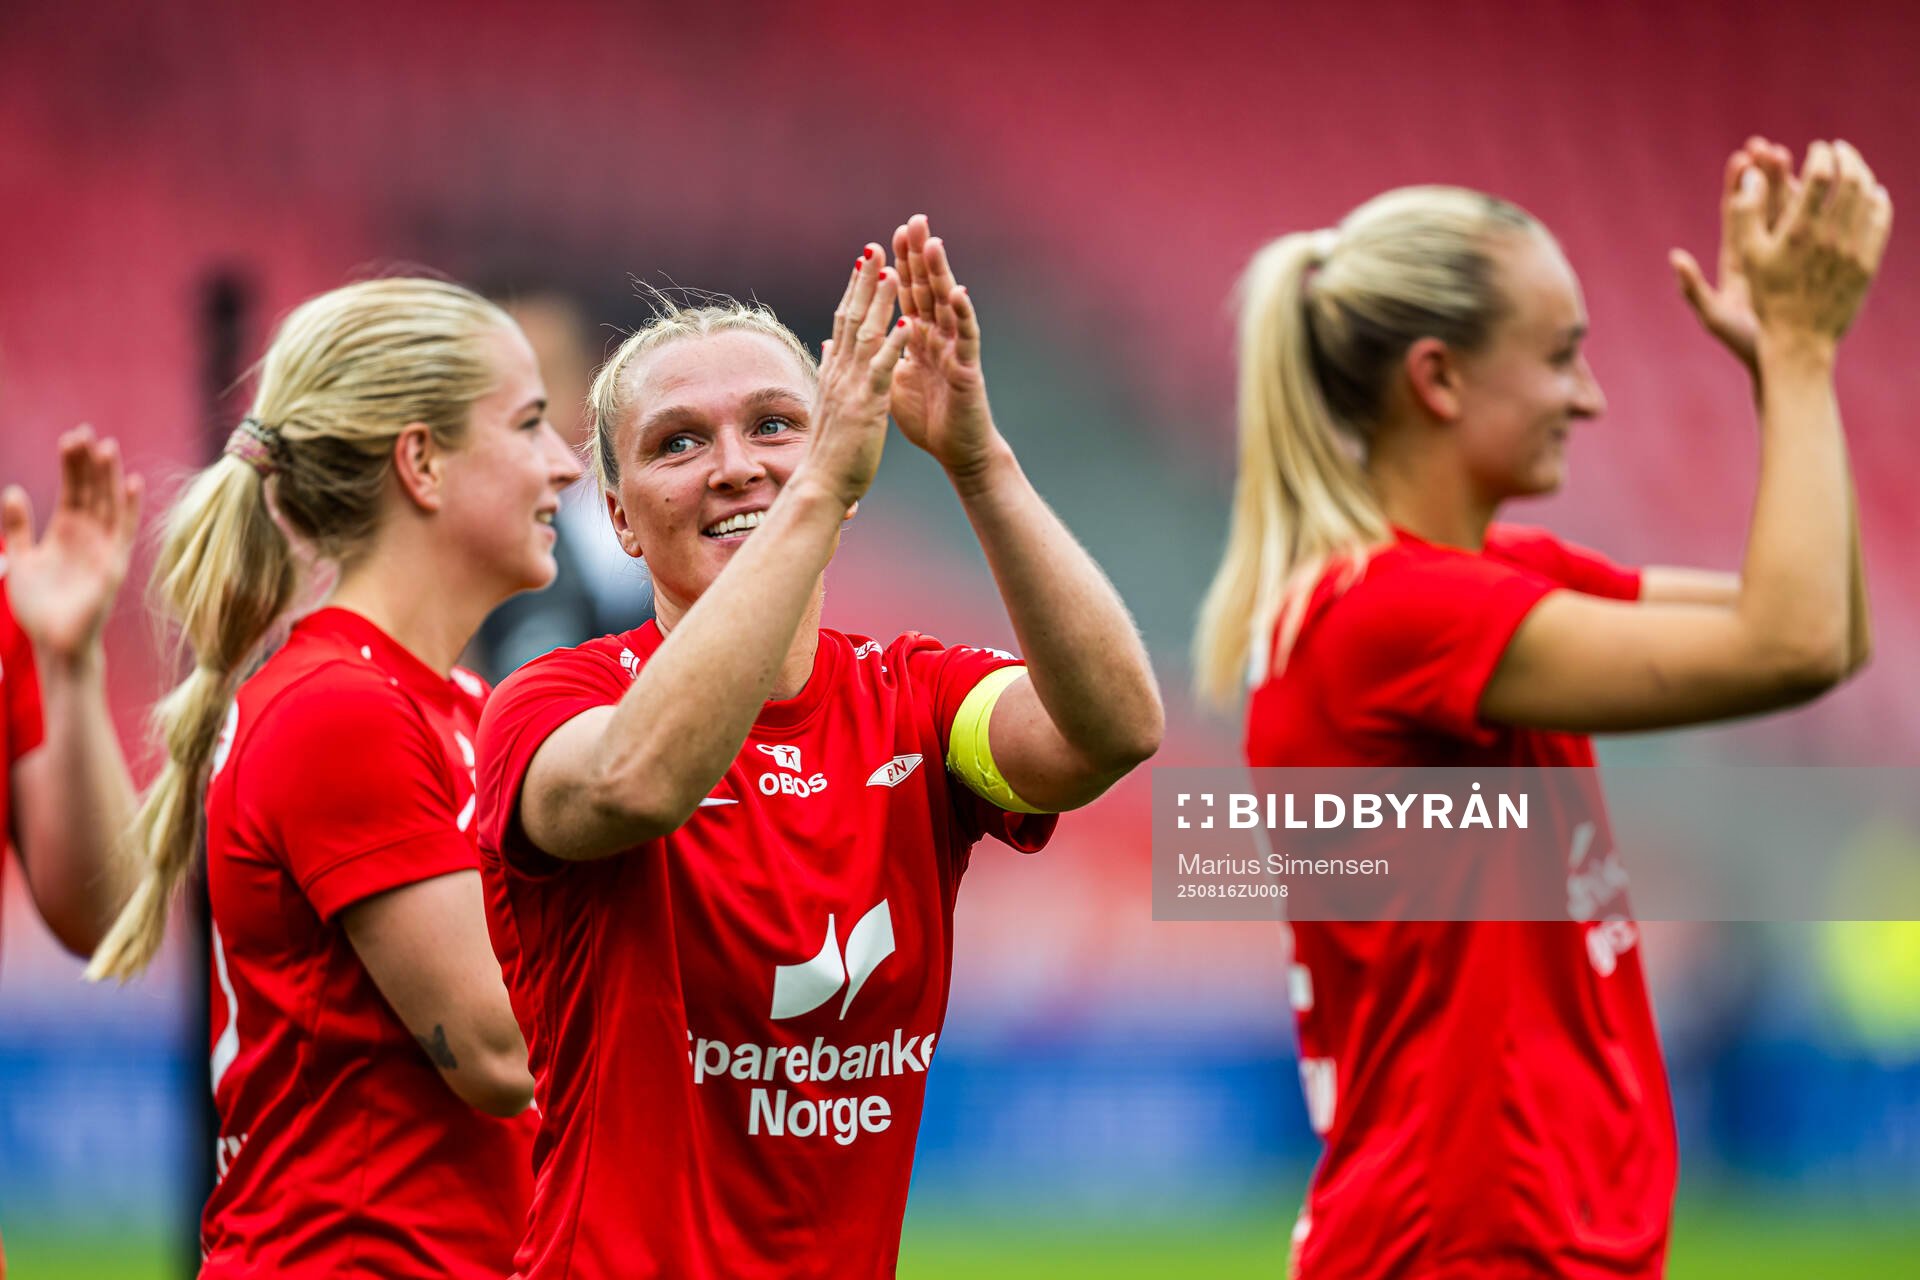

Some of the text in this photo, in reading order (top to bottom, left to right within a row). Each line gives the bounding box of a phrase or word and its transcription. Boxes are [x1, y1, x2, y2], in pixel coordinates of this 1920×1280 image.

[758, 772, 828, 798] OBOS
[686, 1028, 936, 1084] parebanke
[748, 1087, 892, 1146] Norge
